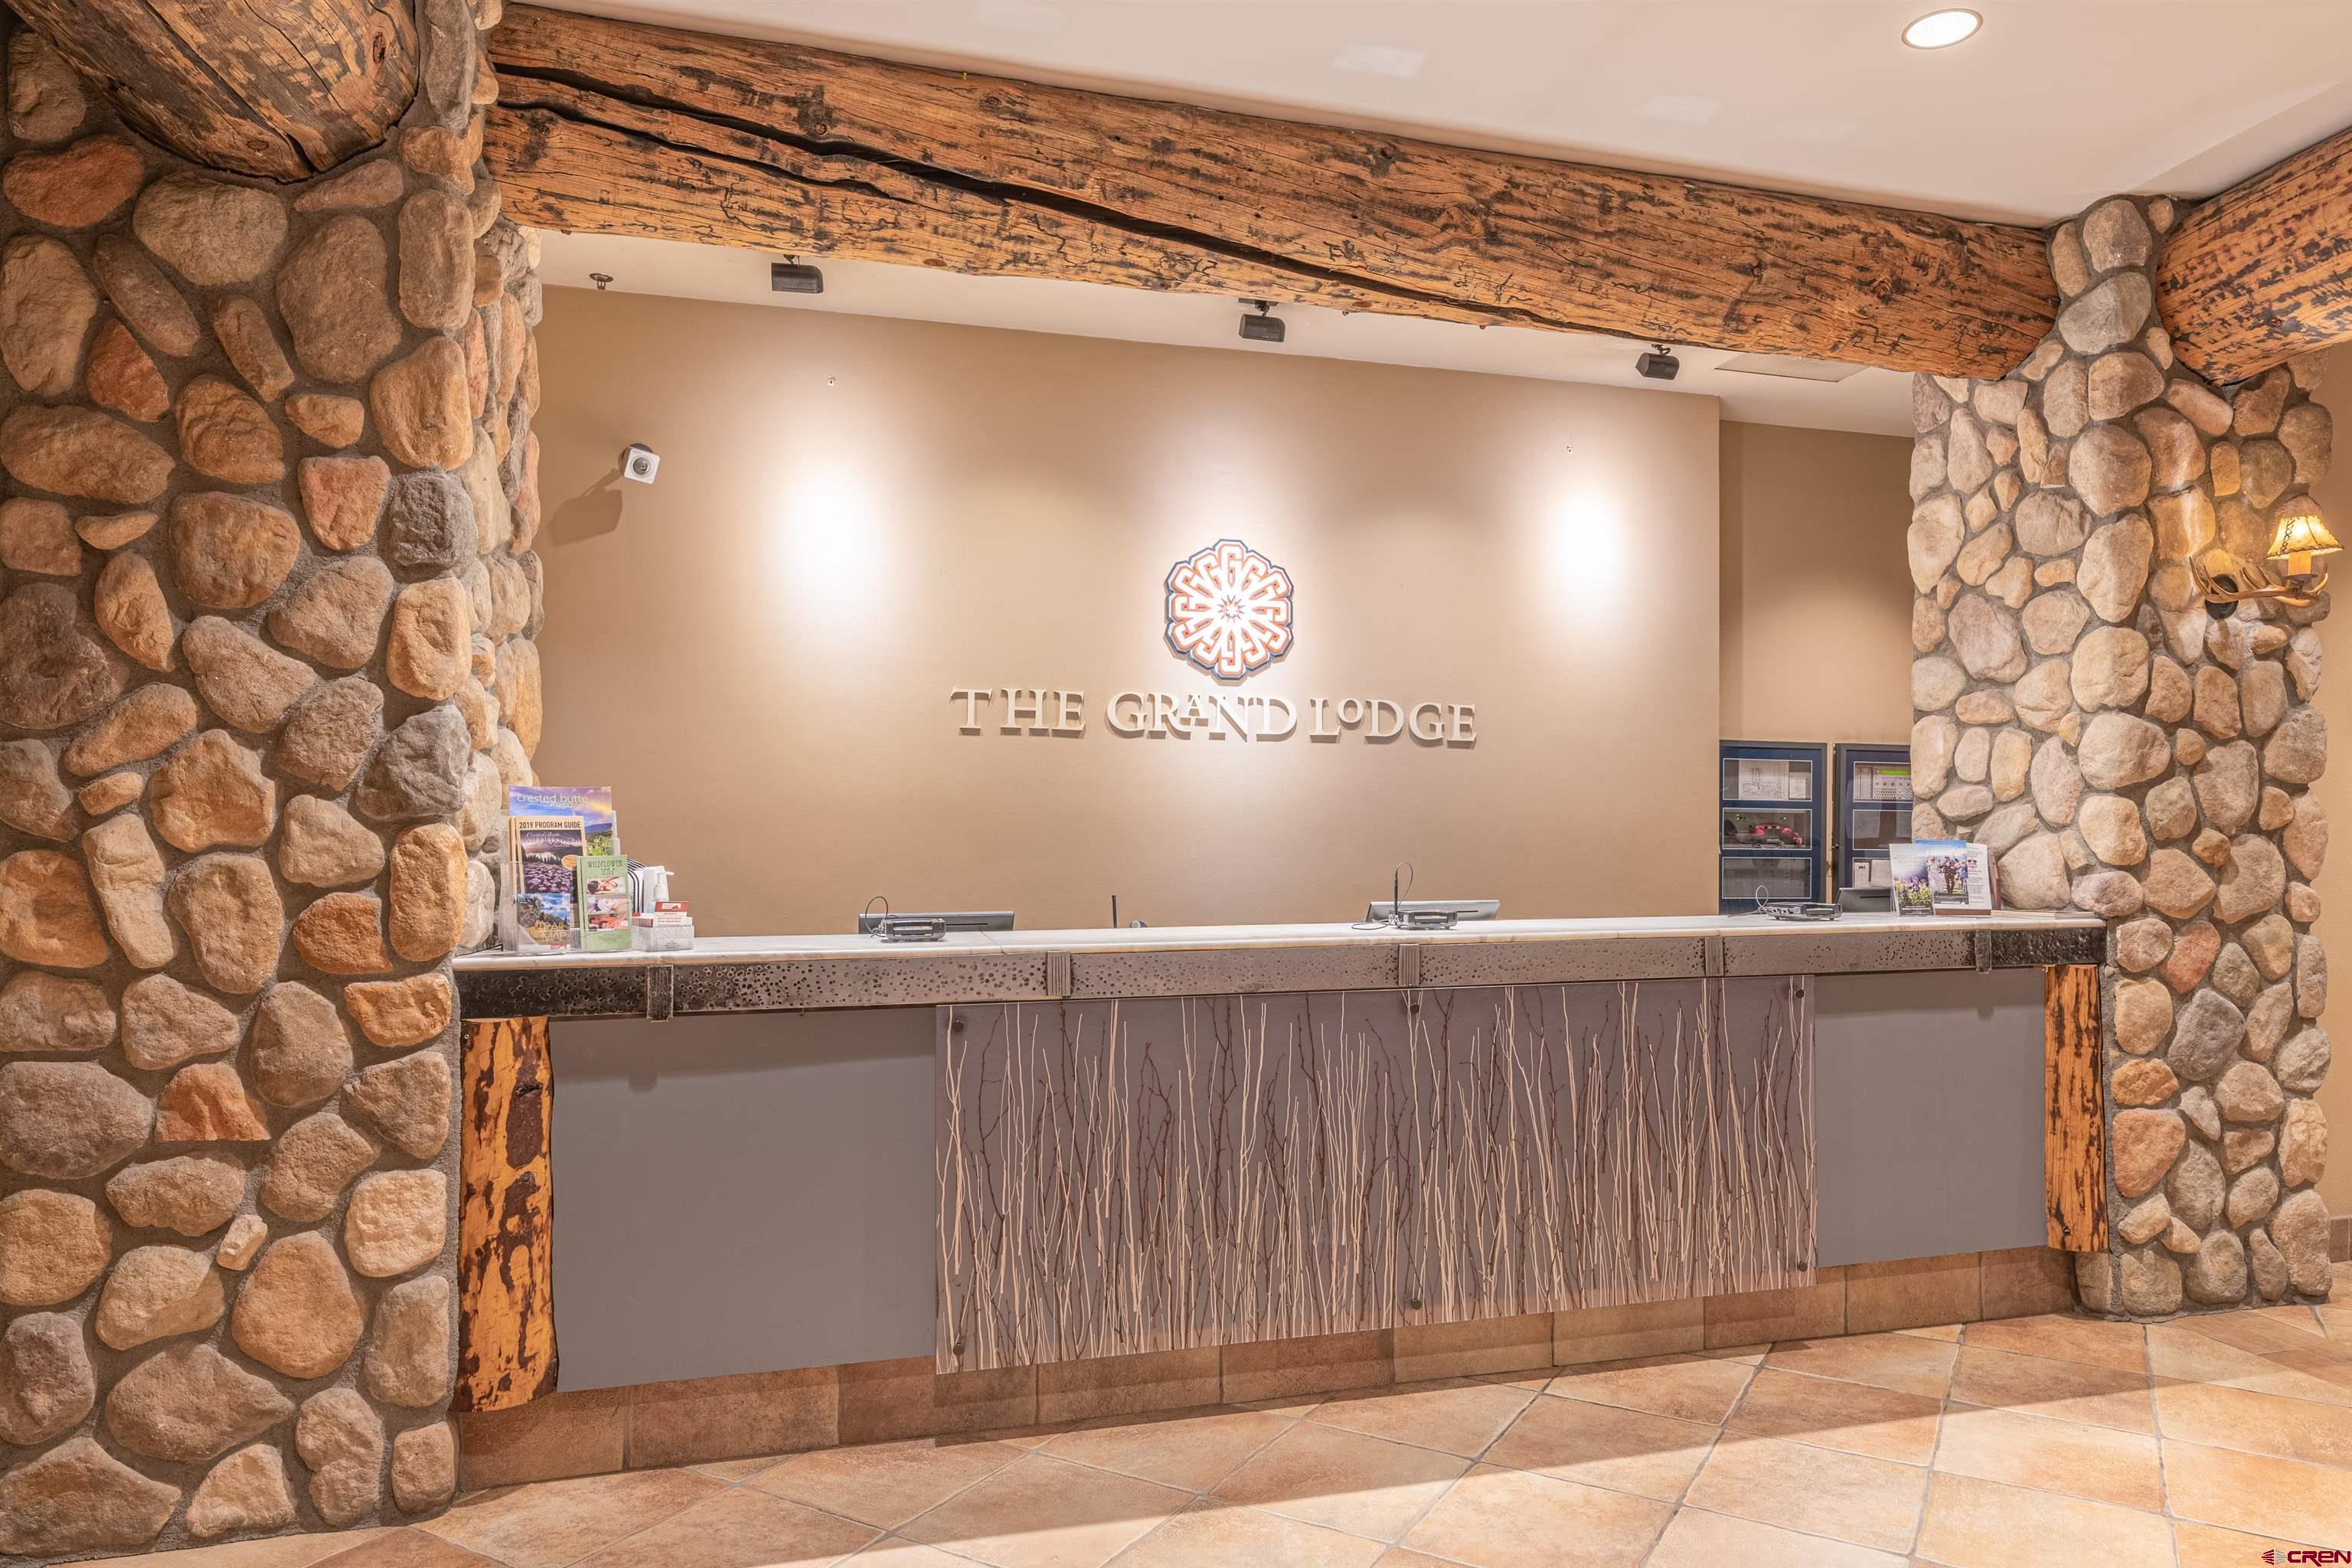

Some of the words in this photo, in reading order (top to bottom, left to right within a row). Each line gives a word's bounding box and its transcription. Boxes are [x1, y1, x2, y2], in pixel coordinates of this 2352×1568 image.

[949, 687, 1086, 730] THE
[1106, 691, 1298, 739] GRAND
[1309, 697, 1477, 742] LODGE
[517, 793, 557, 803] crested
[560, 793, 588, 803] butte
[537, 922, 565, 931] TRAIL
[541, 932, 567, 940] MAP
